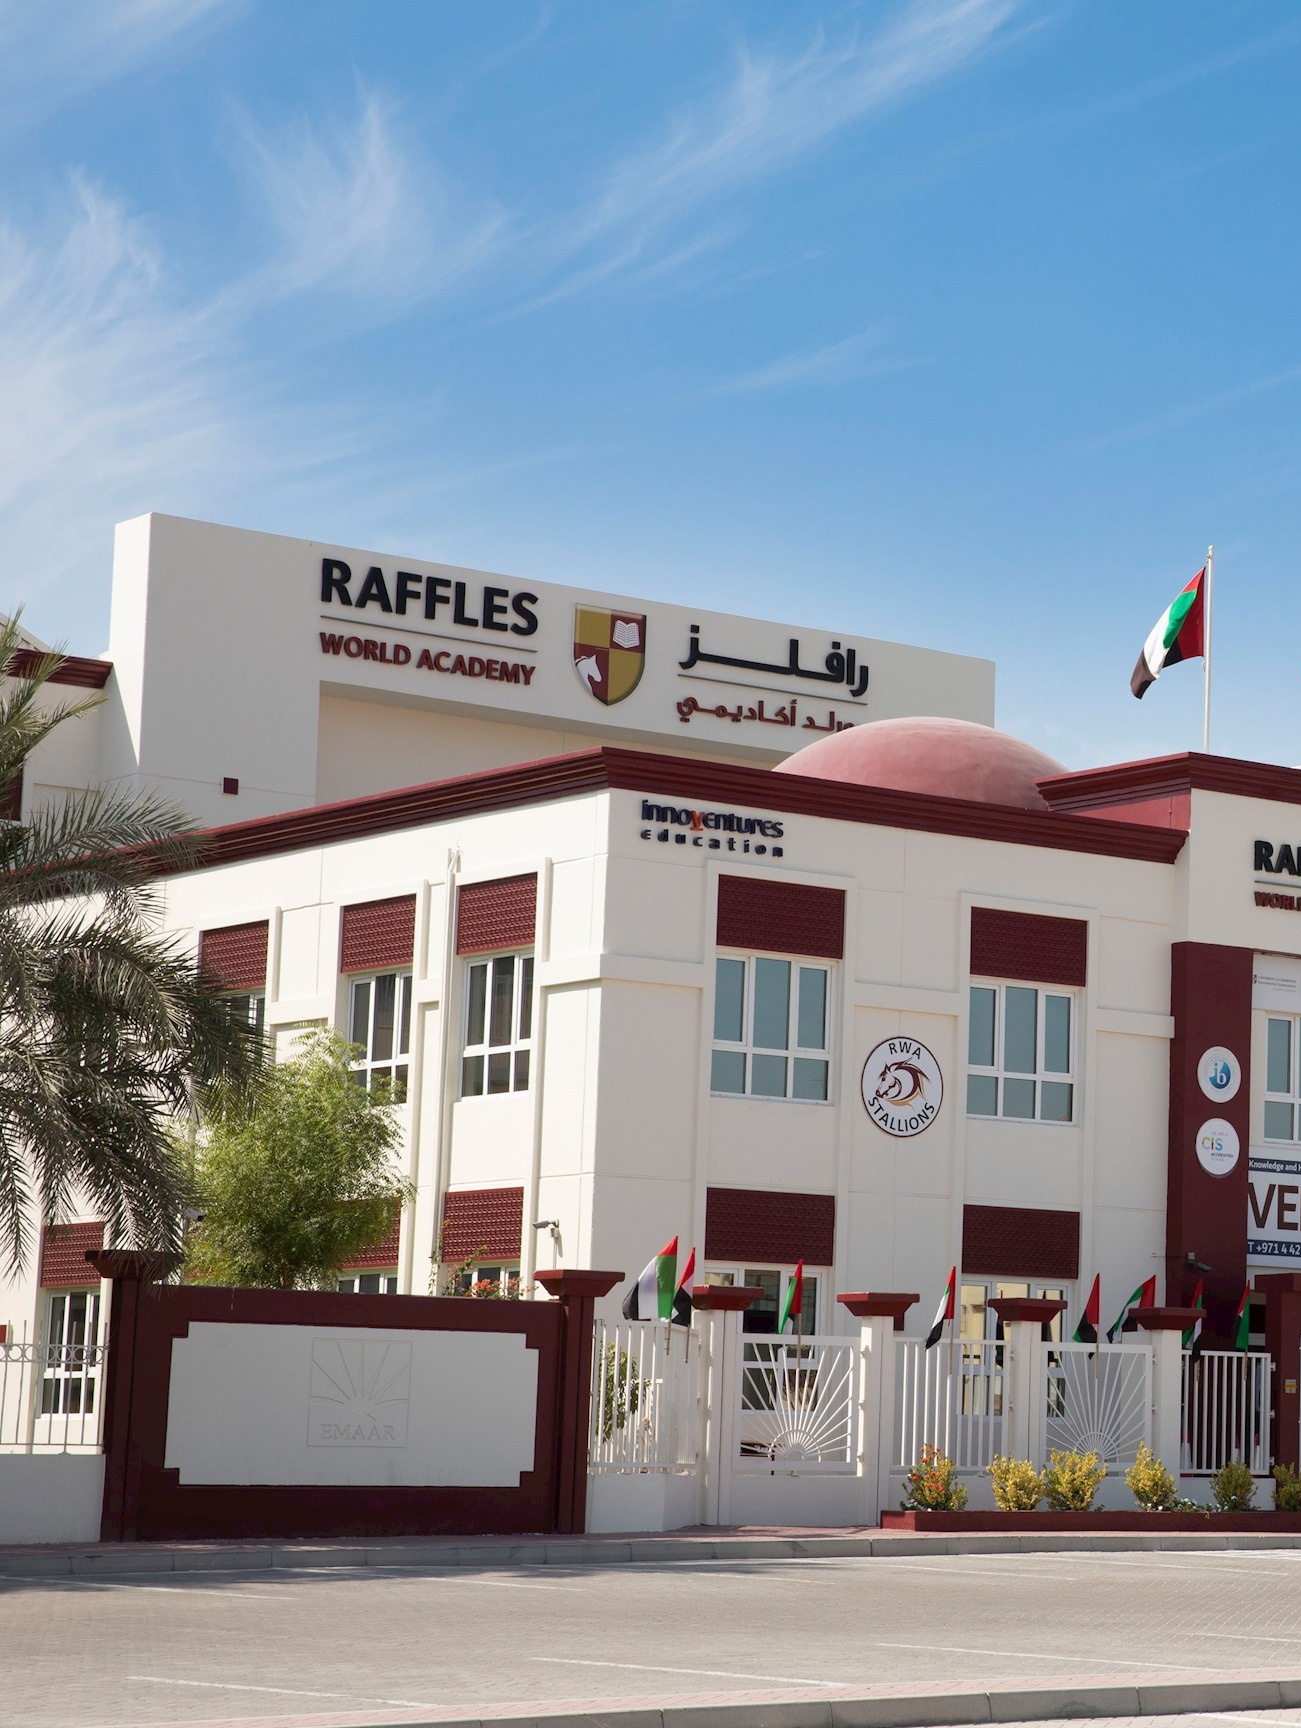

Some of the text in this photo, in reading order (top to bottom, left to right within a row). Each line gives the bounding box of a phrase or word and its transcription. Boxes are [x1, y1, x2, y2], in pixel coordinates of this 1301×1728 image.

[321, 558, 539, 636] RAFFLES
[320, 632, 536, 686] WORLD ACADEMY
[677, 697, 798, 727] أكاديمي
[641, 799, 784, 838] innoventures
[640, 829, 784, 858] education
[888, 1041, 921, 1059] RWA
[868, 1096, 935, 1132] STALLIONS
[1202, 1137, 1223, 1151] CIS
[1249, 1160, 1284, 1171] Knowledge
[1285, 1163, 1297, 1171] and
[1247, 1241, 1254, 1253] T
[1256, 1242, 1279, 1254] +971
[1281, 1244, 1288, 1254] 4
[320, 1423, 395, 1441] EMAAR
